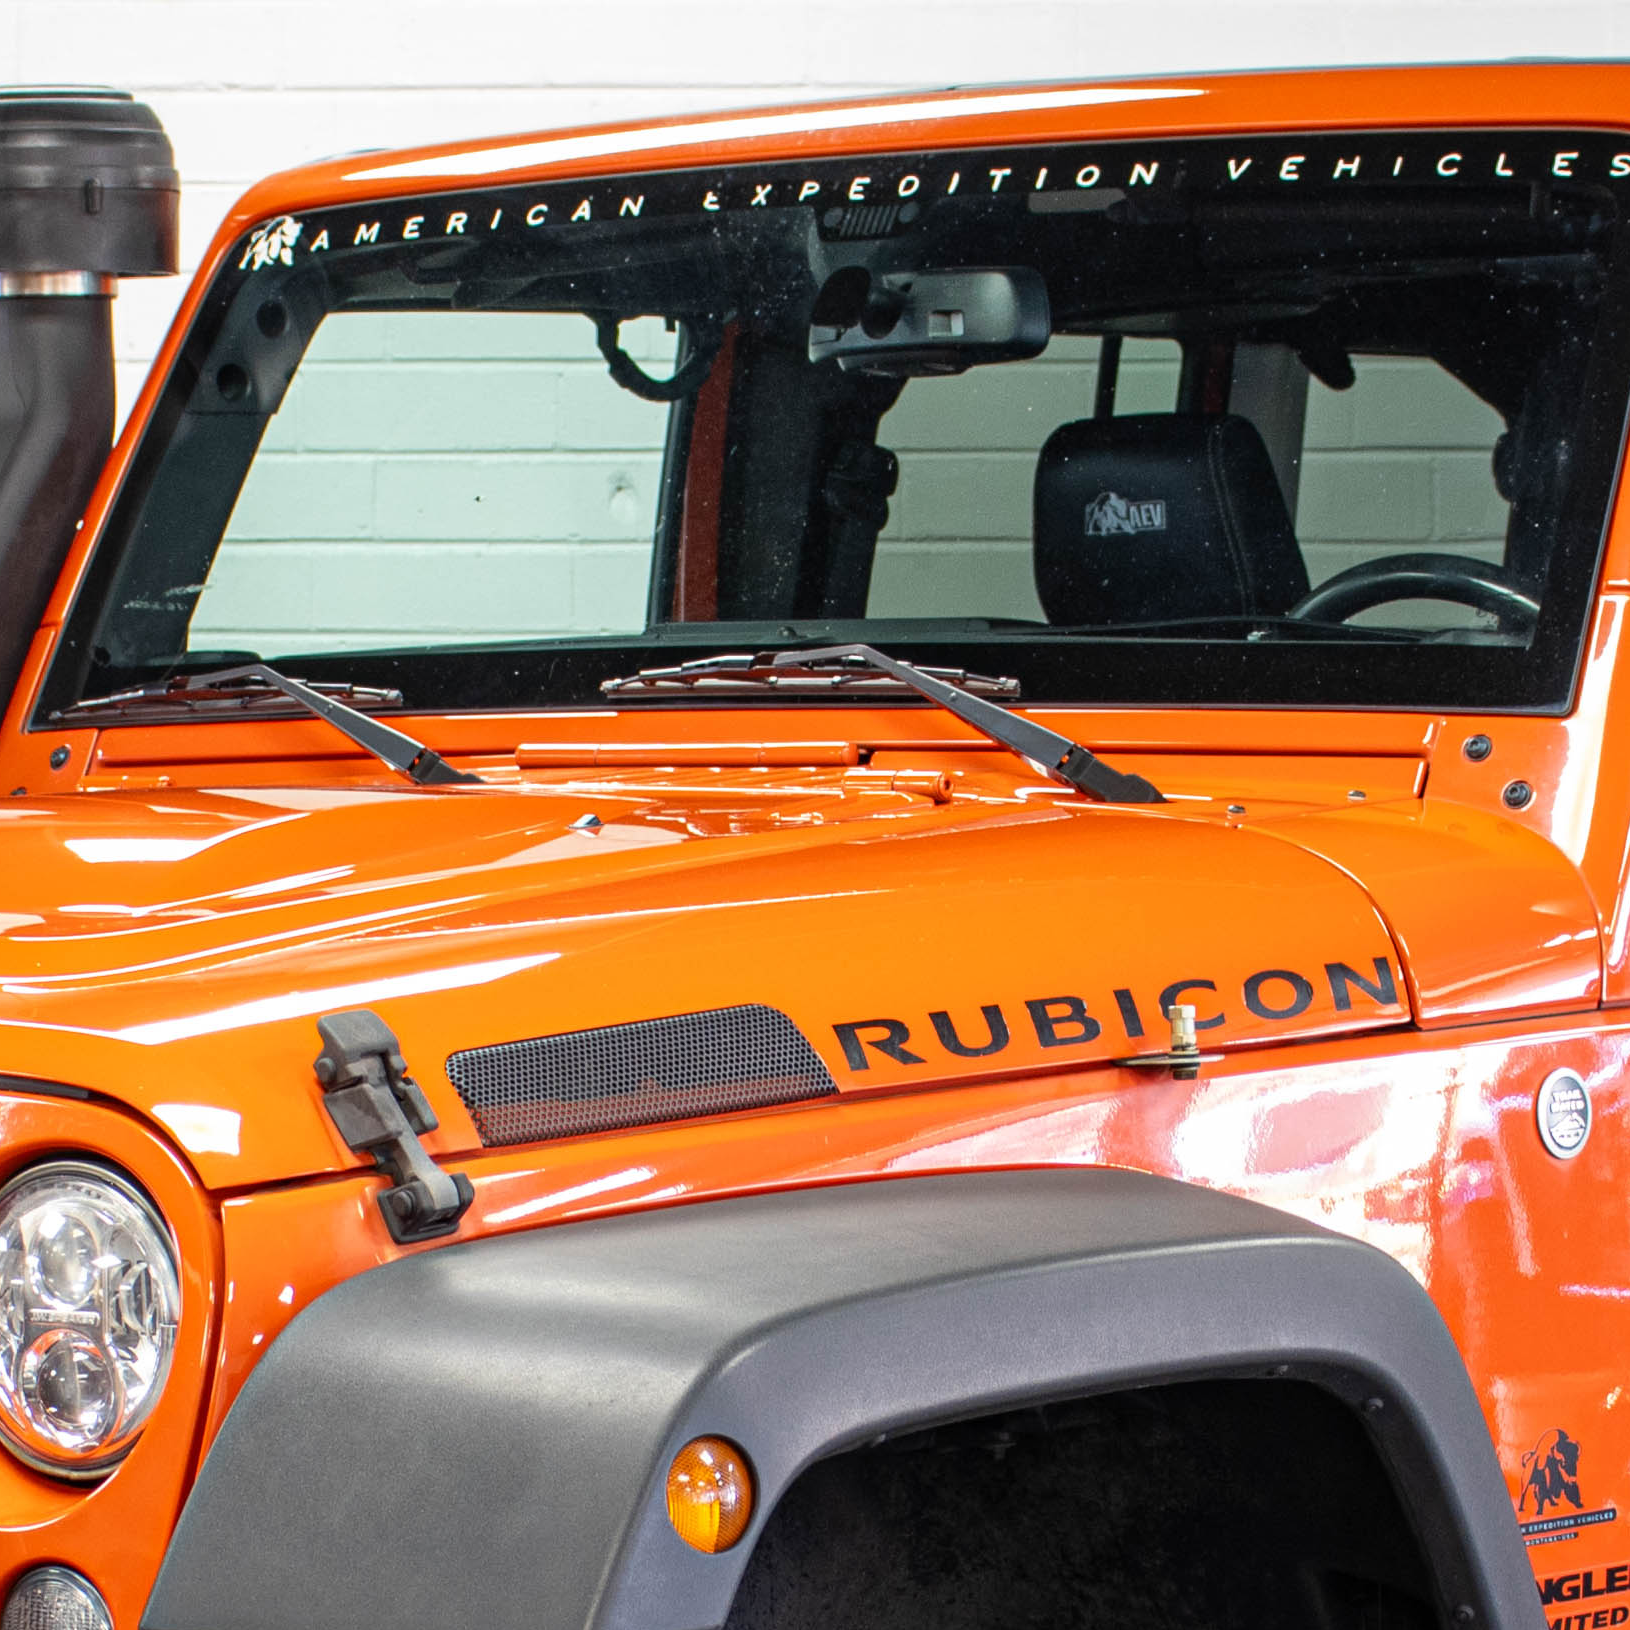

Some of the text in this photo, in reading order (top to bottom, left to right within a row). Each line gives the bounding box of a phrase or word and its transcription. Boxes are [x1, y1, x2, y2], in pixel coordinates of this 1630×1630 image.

[310, 195, 645, 252] AMERICAN
[703, 162, 1159, 211] EXPEDITION
[1129, 503, 1162, 528] AEV
[832, 956, 1401, 1072] RUBICON
